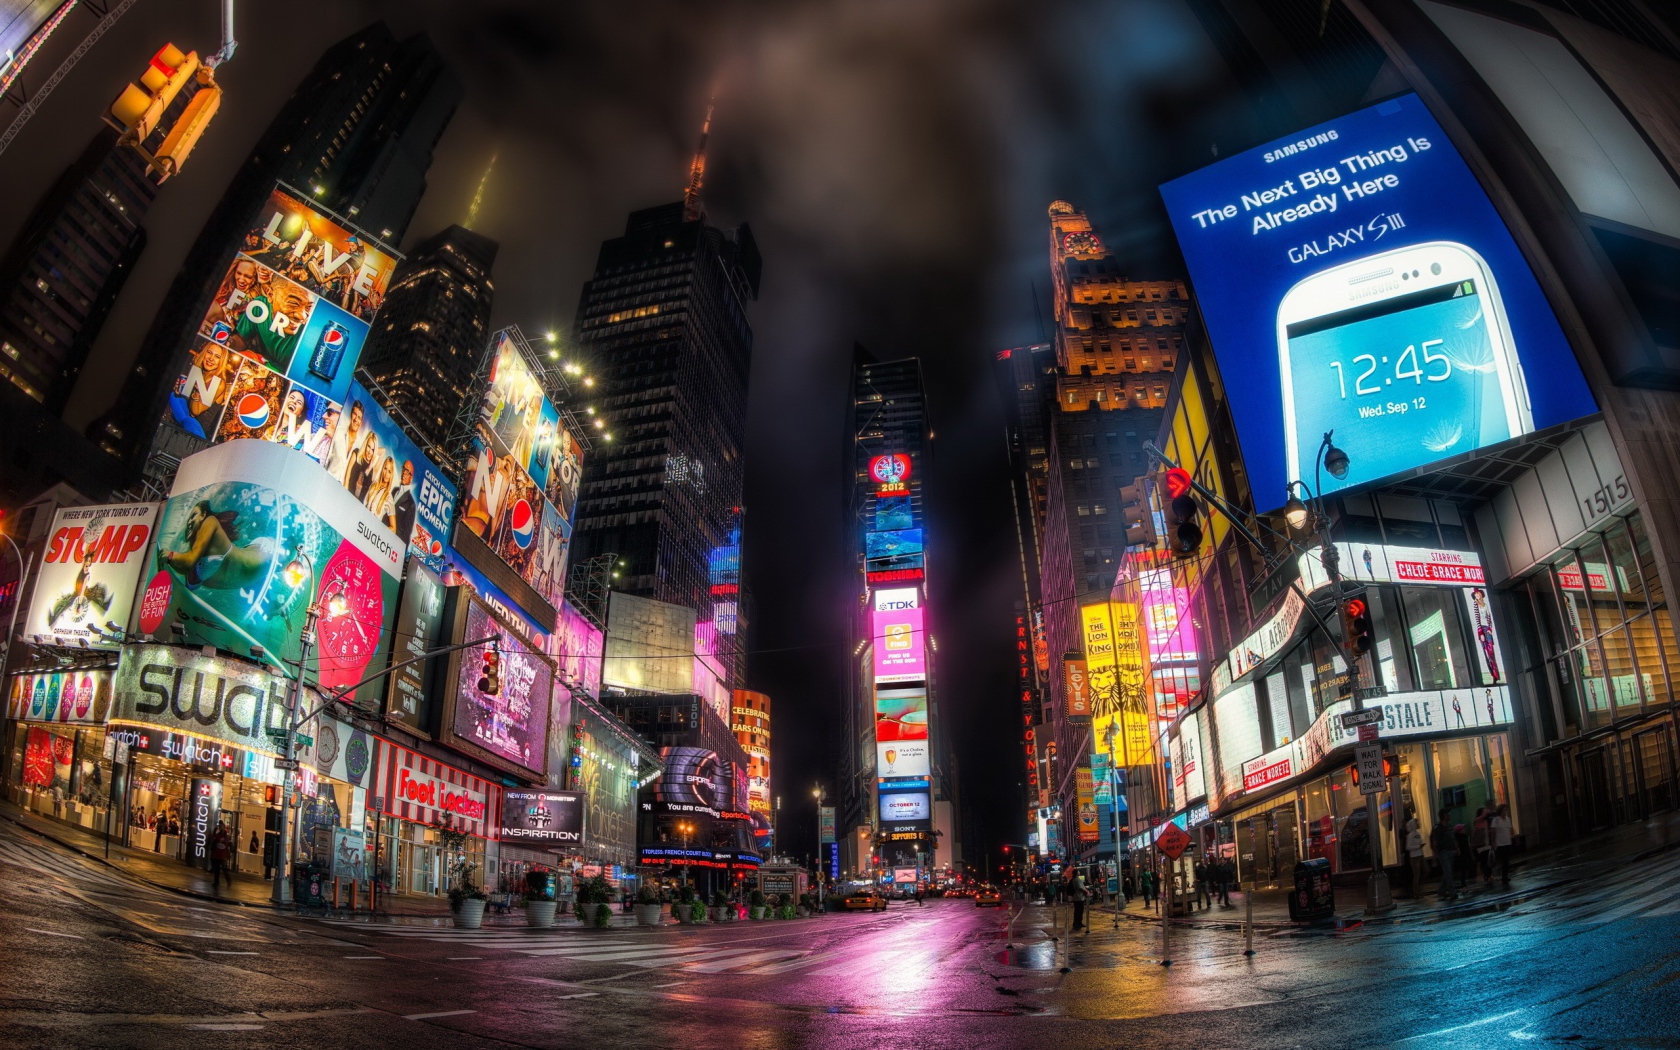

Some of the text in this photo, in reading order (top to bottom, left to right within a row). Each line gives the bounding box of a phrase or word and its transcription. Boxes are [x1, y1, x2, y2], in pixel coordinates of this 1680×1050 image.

[1264, 130, 1339, 163] SAMSUNG
[1192, 136, 1432, 229] The Next Big Thing Is
[1252, 172, 1400, 236] Already Here
[262, 212, 378, 297] LIVE
[1288, 224, 1364, 264] GALAXY
[1348, 280, 1399, 301] SAMSUNG
[226, 288, 291, 338] FOR
[1330, 339, 1452, 400] 12:45
[1358, 397, 1426, 418] Wed. Sep 12
[552, 447, 580, 500] FOR
[425, 470, 454, 500] CATCH EVERY
[882, 482, 904, 492] 2012
[420, 478, 452, 524] EPIC
[1584, 474, 1630, 520] 1515
[62, 507, 149, 520] WHERE NEW YORK TURNS IT UP
[417, 502, 448, 536] MOMENT
[44, 524, 149, 564] STOMP
[356, 521, 392, 560] swatch
[1431, 552, 1462, 563] STARRING
[868, 569, 924, 582] TOSHIBA
[1400, 562, 1430, 579] CHLOË
[1432, 565, 1462, 579] GRACE
[144, 585, 170, 602] PUSH
[1262, 576, 1283, 599] 7 AV
[141, 607, 164, 619] OF FUN
[151, 600, 166, 608] BUTTON
[887, 600, 914, 610] TDK
[74, 628, 90, 637] THEATRE
[1088, 632, 1108, 642] LION
[1088, 644, 1111, 656] KING
[1016, 617, 1037, 785] ERNST & YOUNG
[1363, 688, 1381, 698] W 45
[1364, 710, 1376, 719] WAY
[162, 740, 220, 765] swatch
[1361, 750, 1376, 759] WAIT
[1248, 758, 1266, 772] STARRING
[1248, 763, 1290, 786] GRACE MORETZ
[1362, 770, 1382, 780] WALK
[1364, 761, 1377, 769] FOR
[400, 768, 435, 806] Foot
[440, 784, 485, 820] Locker
[1362, 780, 1383, 791] SIGNAL
[195, 795, 209, 857] swatch
[502, 828, 577, 840] INSPIRATION
